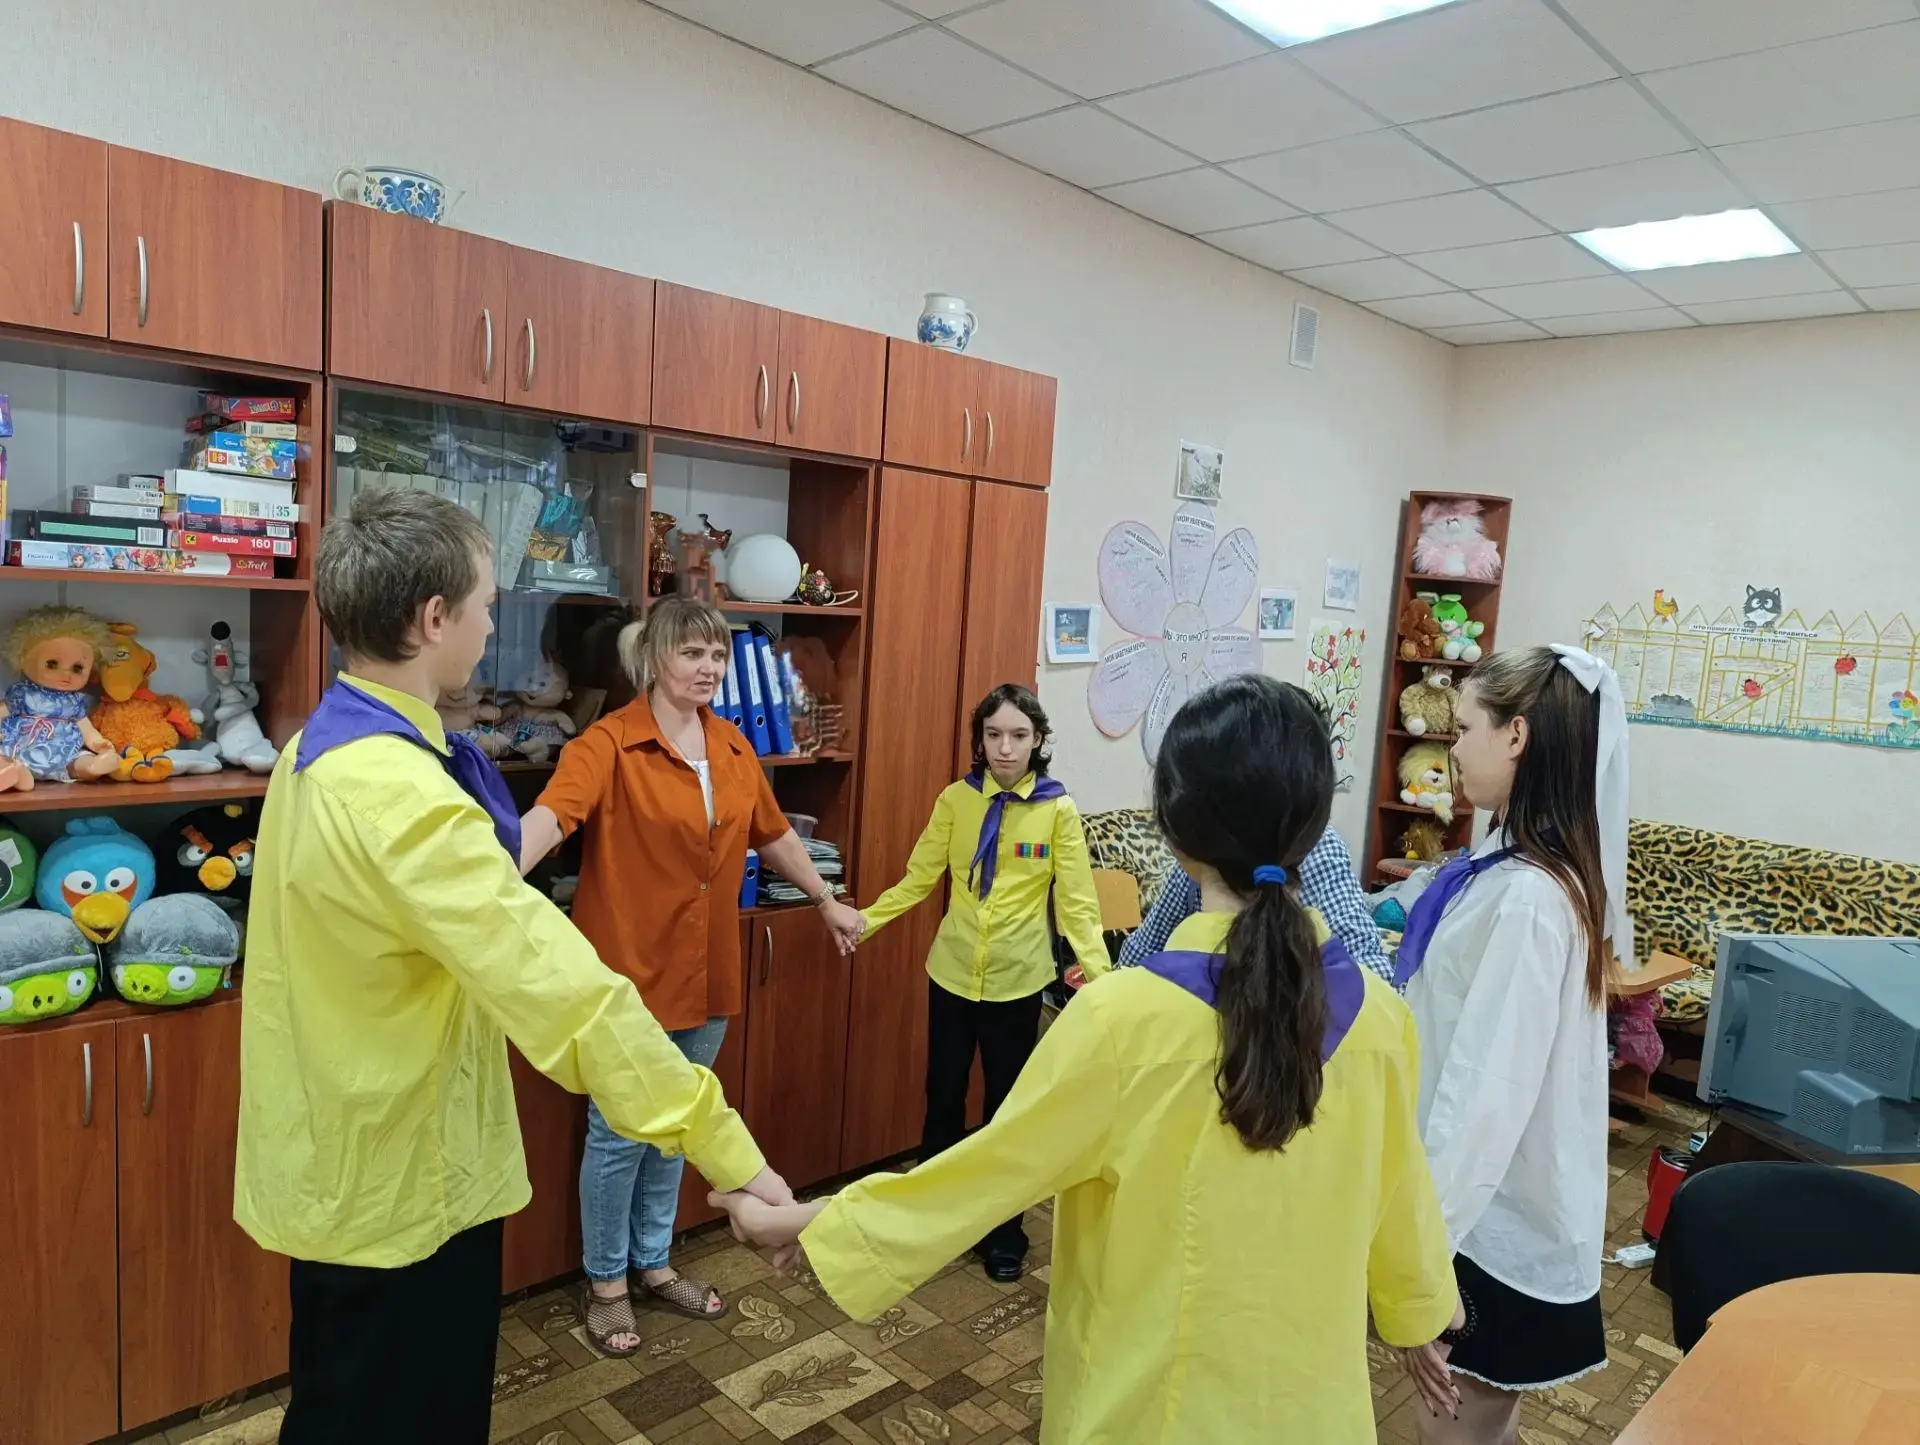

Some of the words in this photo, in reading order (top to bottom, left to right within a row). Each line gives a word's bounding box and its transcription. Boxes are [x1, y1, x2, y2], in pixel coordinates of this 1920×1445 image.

[276, 505, 290, 518] 35
[212, 535, 239, 544] Puzzle
[251, 539, 271, 549] 160
